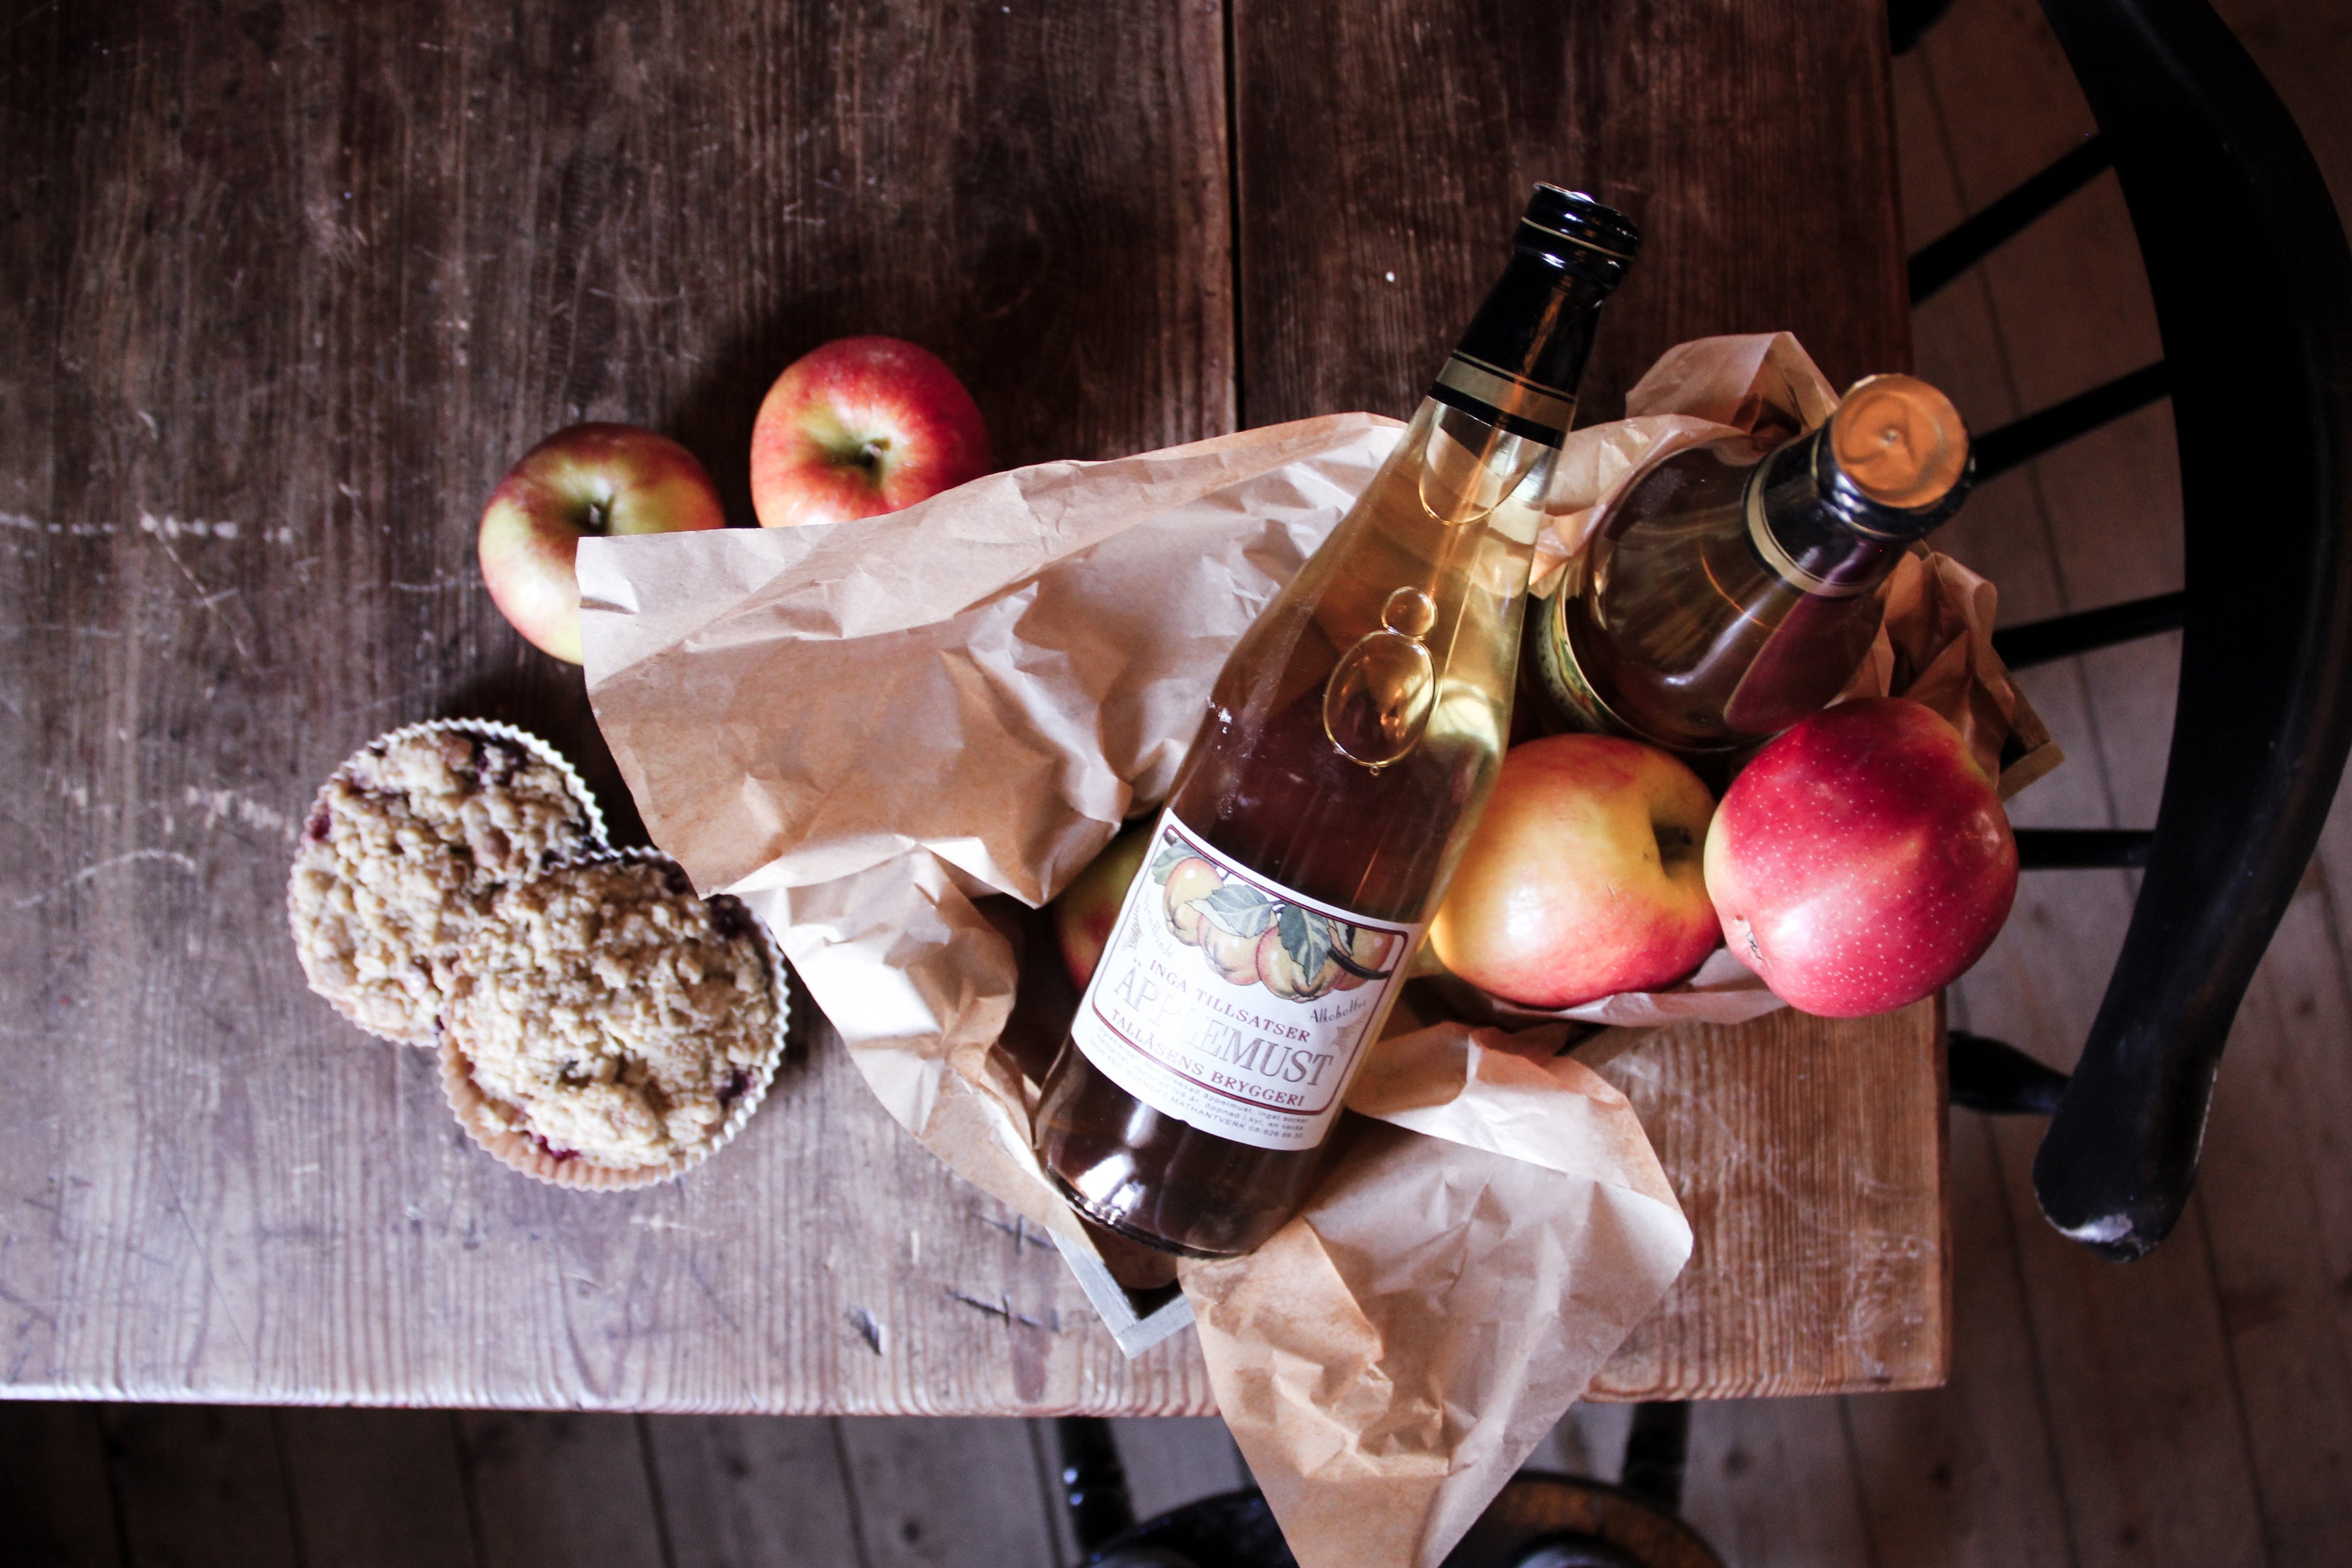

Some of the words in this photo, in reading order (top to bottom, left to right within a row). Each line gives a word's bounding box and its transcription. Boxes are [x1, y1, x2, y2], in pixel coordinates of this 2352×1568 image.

[1114, 956, 1334, 1087] ÄPPLEMUST
[1149, 959, 1188, 993] INGA
[1196, 988, 1311, 1043] TILLSATSER
[1111, 1008, 1204, 1076] TALLÅSENS
[1210, 1070, 1305, 1107] BRYGGERI
[1170, 1096, 1246, 1130] MATHANTVERK
